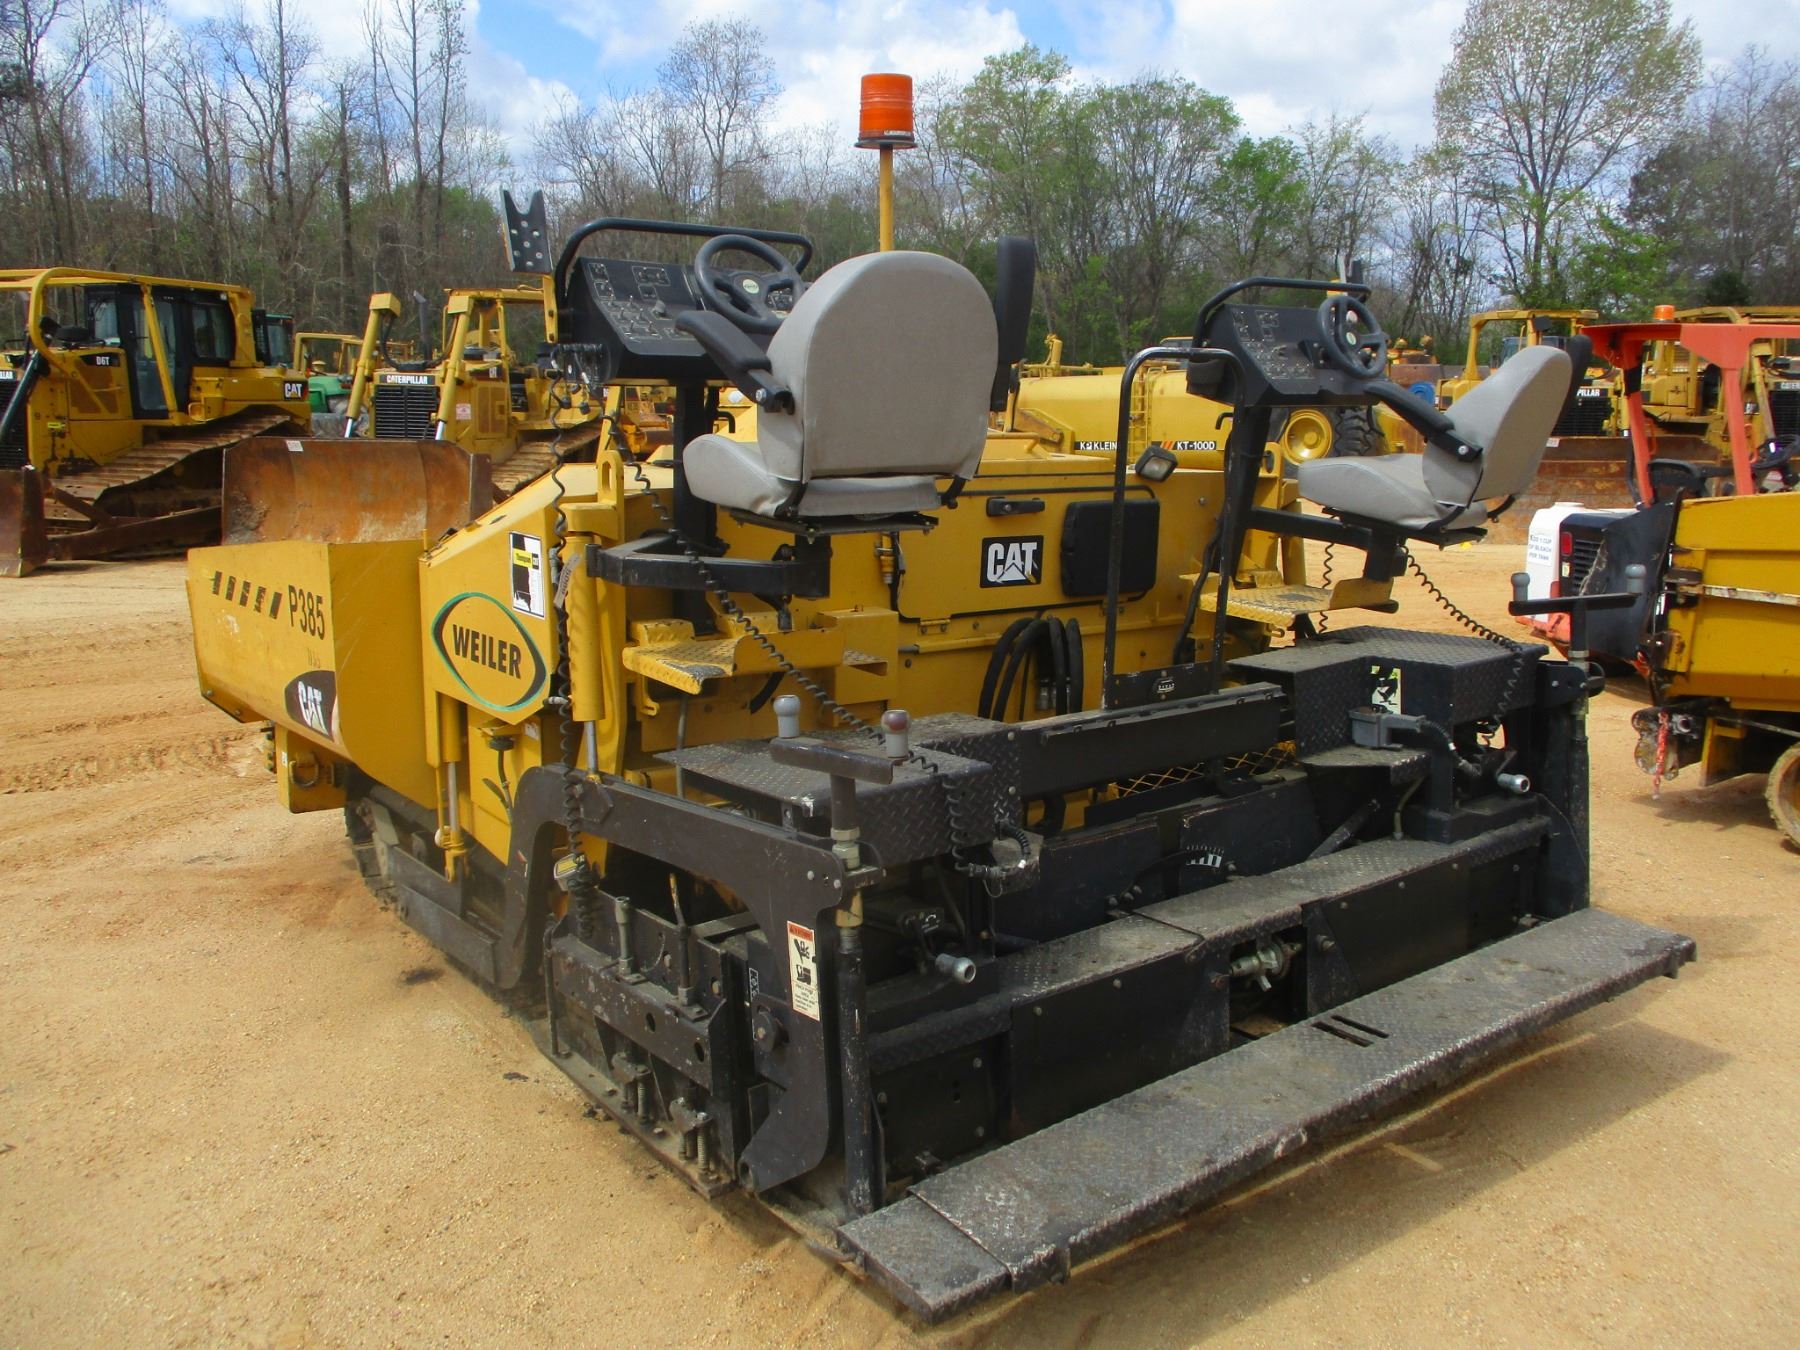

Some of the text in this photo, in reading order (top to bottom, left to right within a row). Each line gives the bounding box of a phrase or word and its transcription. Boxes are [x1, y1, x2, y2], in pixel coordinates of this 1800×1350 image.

[284, 382, 302, 398] CAT
[386, 375, 428, 384] CATERPILLAR
[1176, 441, 1216, 450] KT-100D
[986, 542, 1038, 583] CAT
[288, 584, 325, 640] P385
[452, 624, 522, 680] WEILER
[298, 681, 329, 736] CAT
